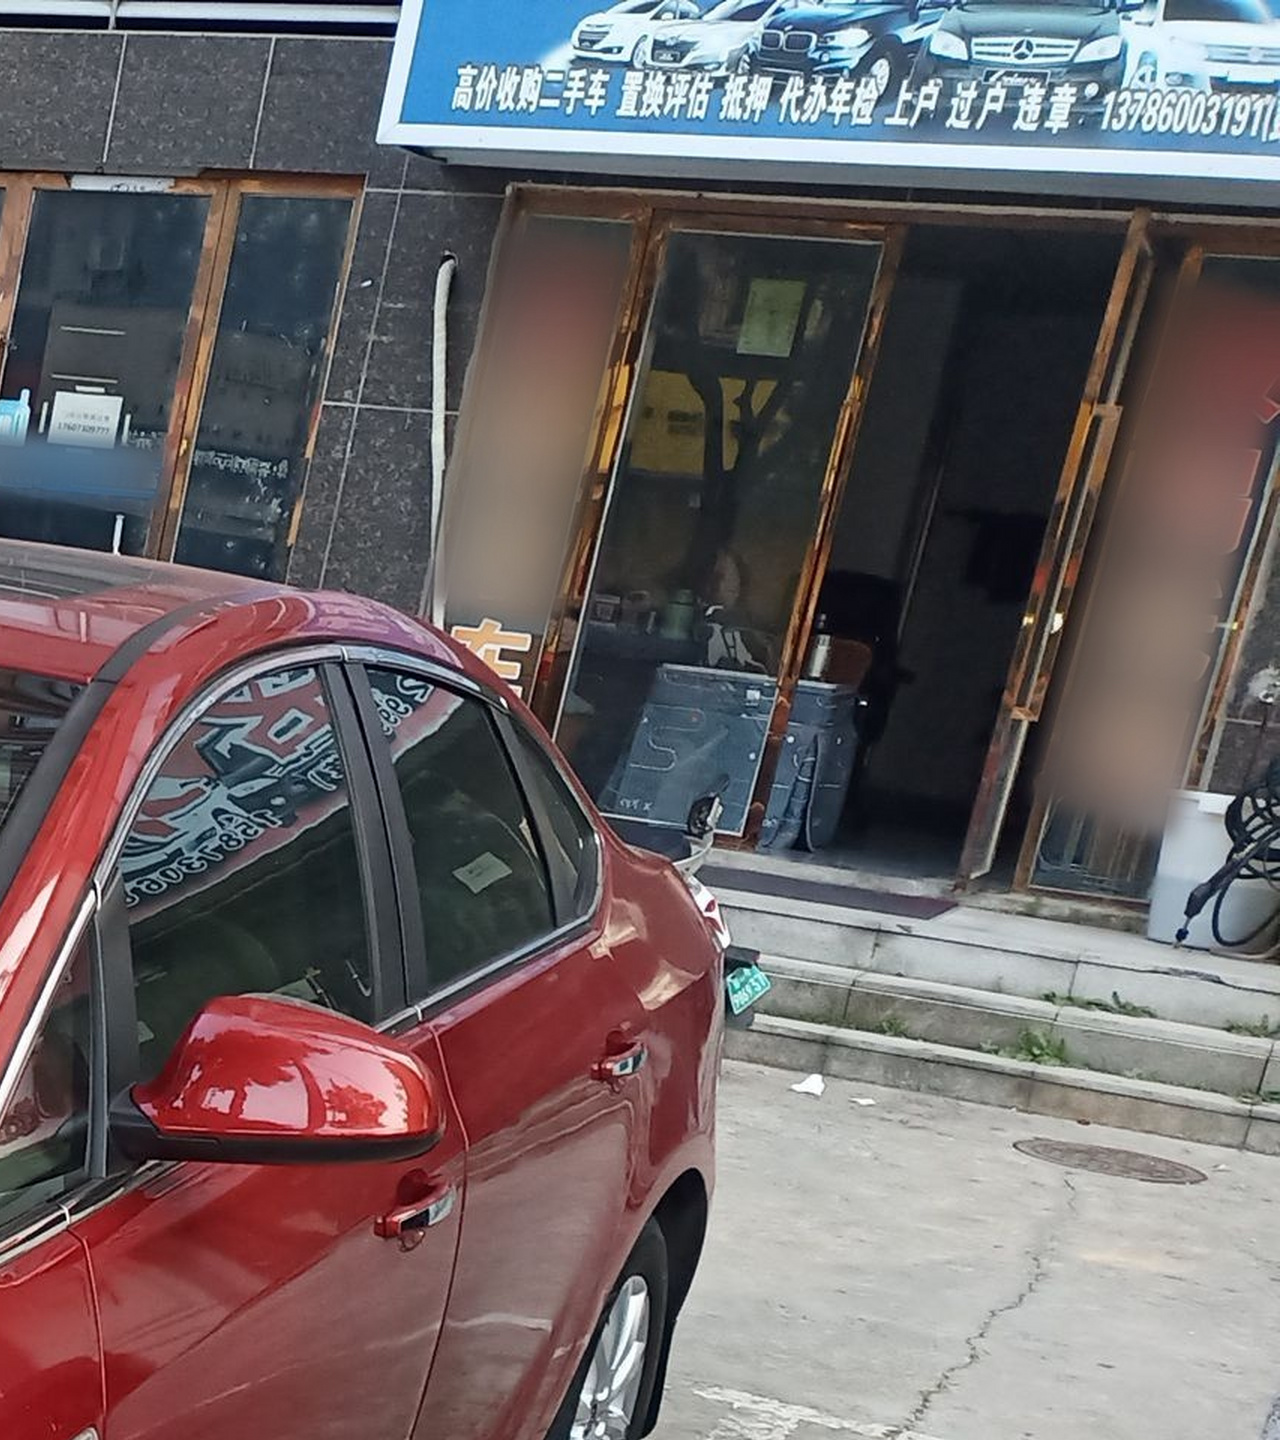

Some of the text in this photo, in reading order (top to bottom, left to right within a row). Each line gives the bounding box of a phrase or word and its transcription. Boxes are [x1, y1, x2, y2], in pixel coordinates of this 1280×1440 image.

[451, 63, 611, 117] 高价收购二手车
[616, 70, 714, 120] 置换评估
[718, 73, 773, 124] 抵押
[778, 74, 879, 127] 代办年检
[884, 79, 941, 128] 上户
[945, 80, 1008, 131] 过户
[1013, 82, 1077, 134] 违章
